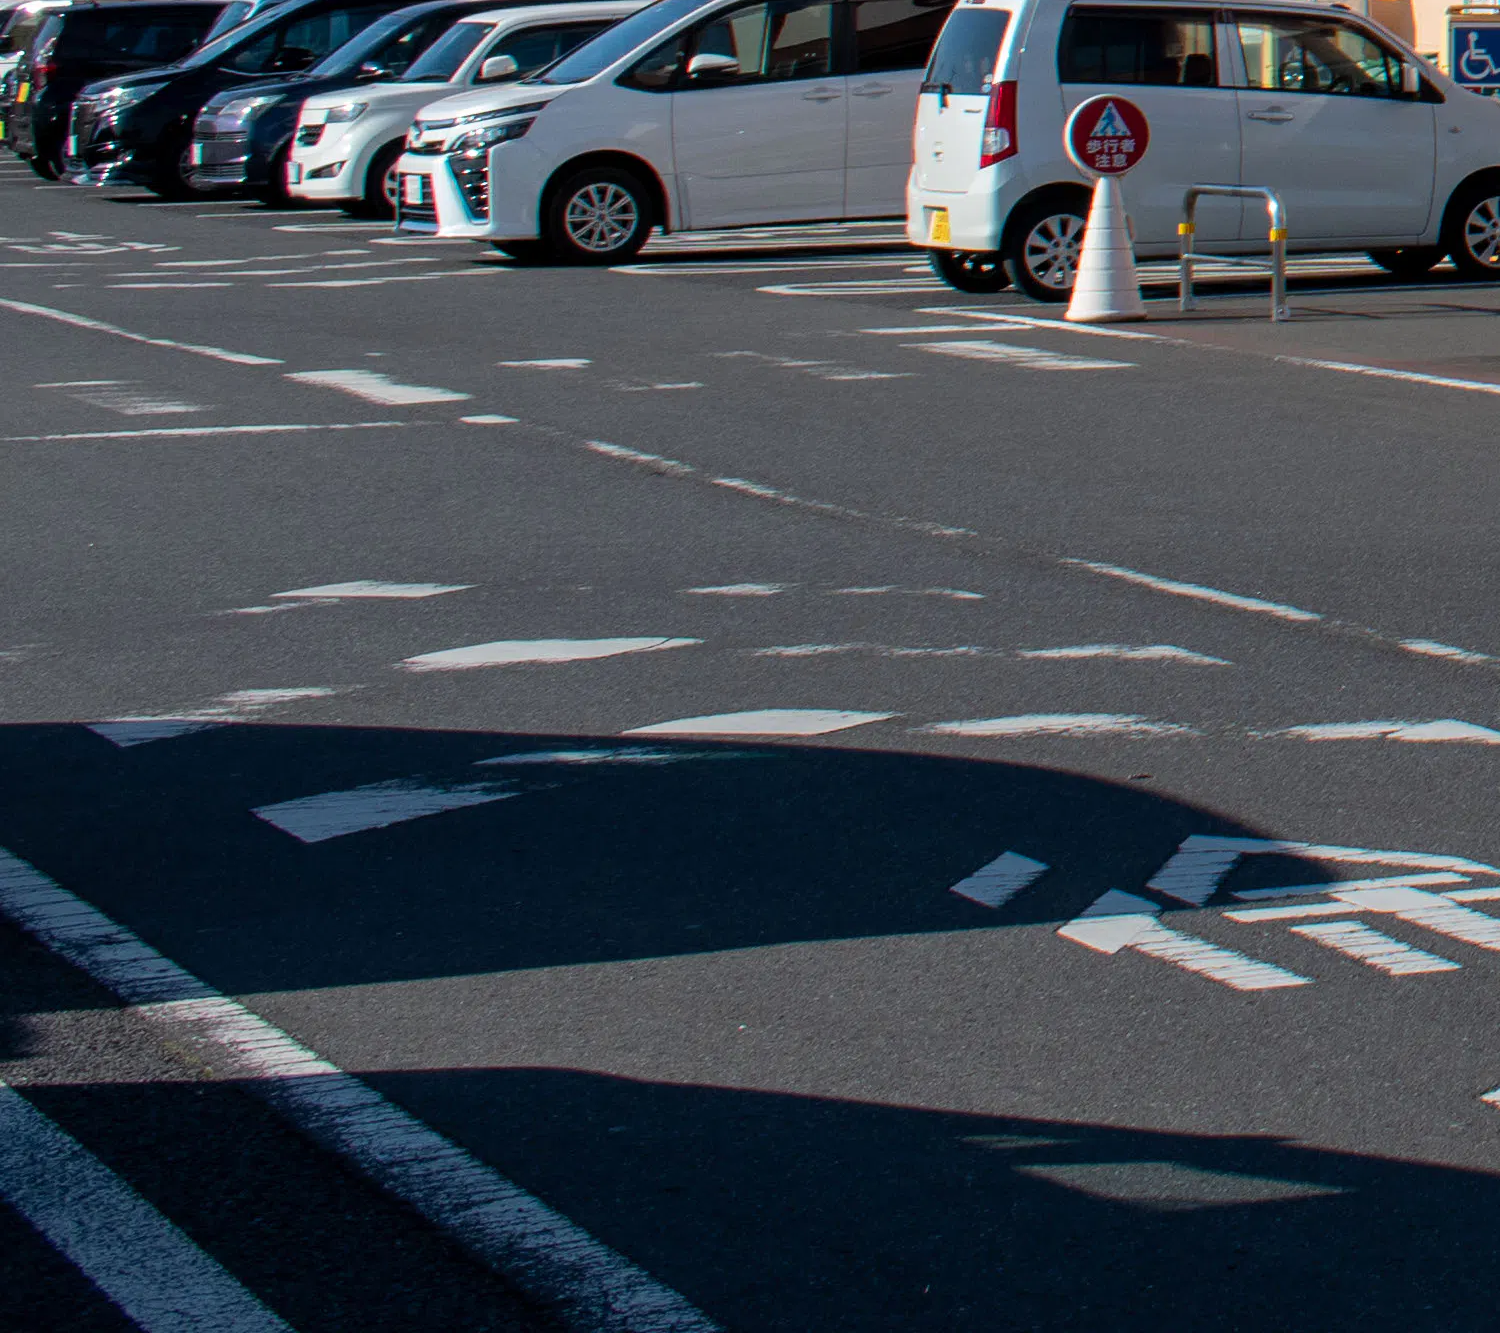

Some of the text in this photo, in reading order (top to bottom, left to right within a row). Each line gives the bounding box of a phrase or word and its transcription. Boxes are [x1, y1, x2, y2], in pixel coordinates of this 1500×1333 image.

[1086, 138, 1137, 154] 歩行者
[1095, 153, 1128, 168] 注意
